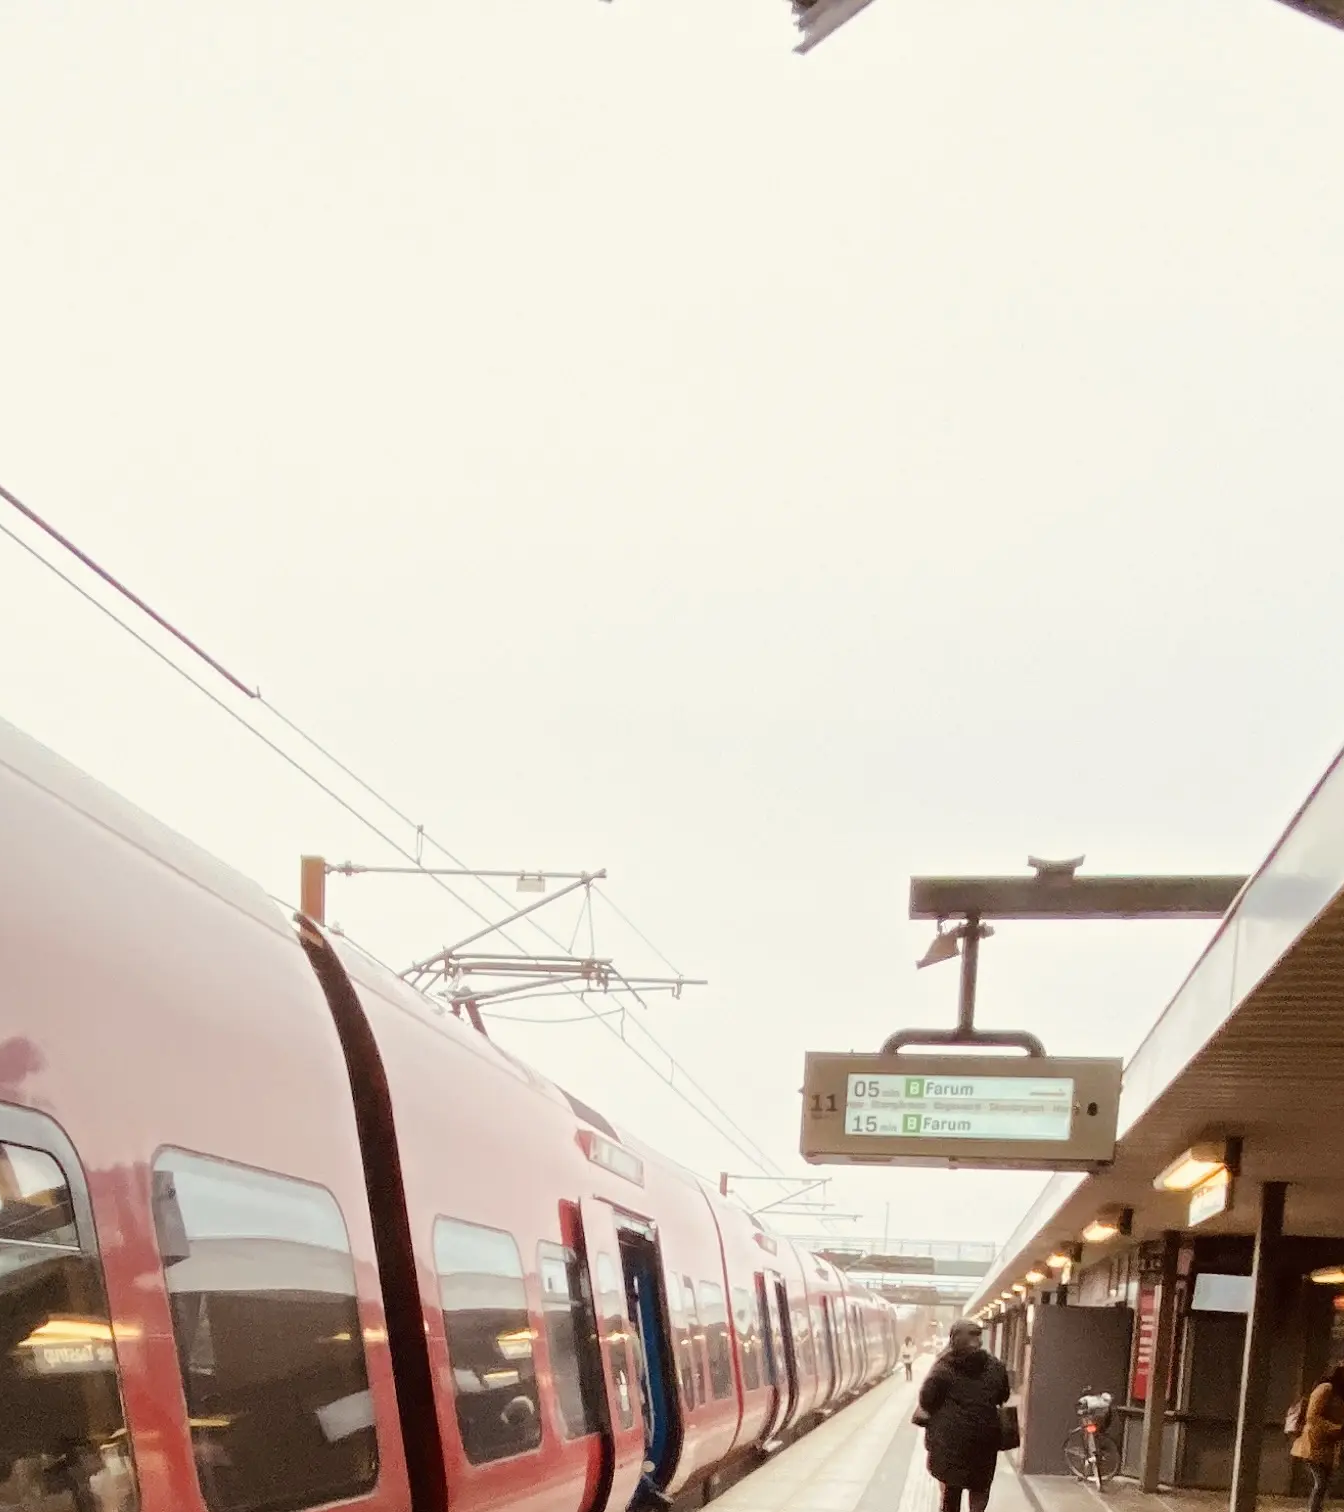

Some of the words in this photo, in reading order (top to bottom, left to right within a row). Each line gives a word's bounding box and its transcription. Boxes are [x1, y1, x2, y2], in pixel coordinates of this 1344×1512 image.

[854, 1081, 879, 1098] 05
[926, 1082, 974, 1096] Farum
[809, 1094, 838, 1112] 11
[851, 1116, 877, 1132] 15
[923, 1117, 971, 1131] Farum
